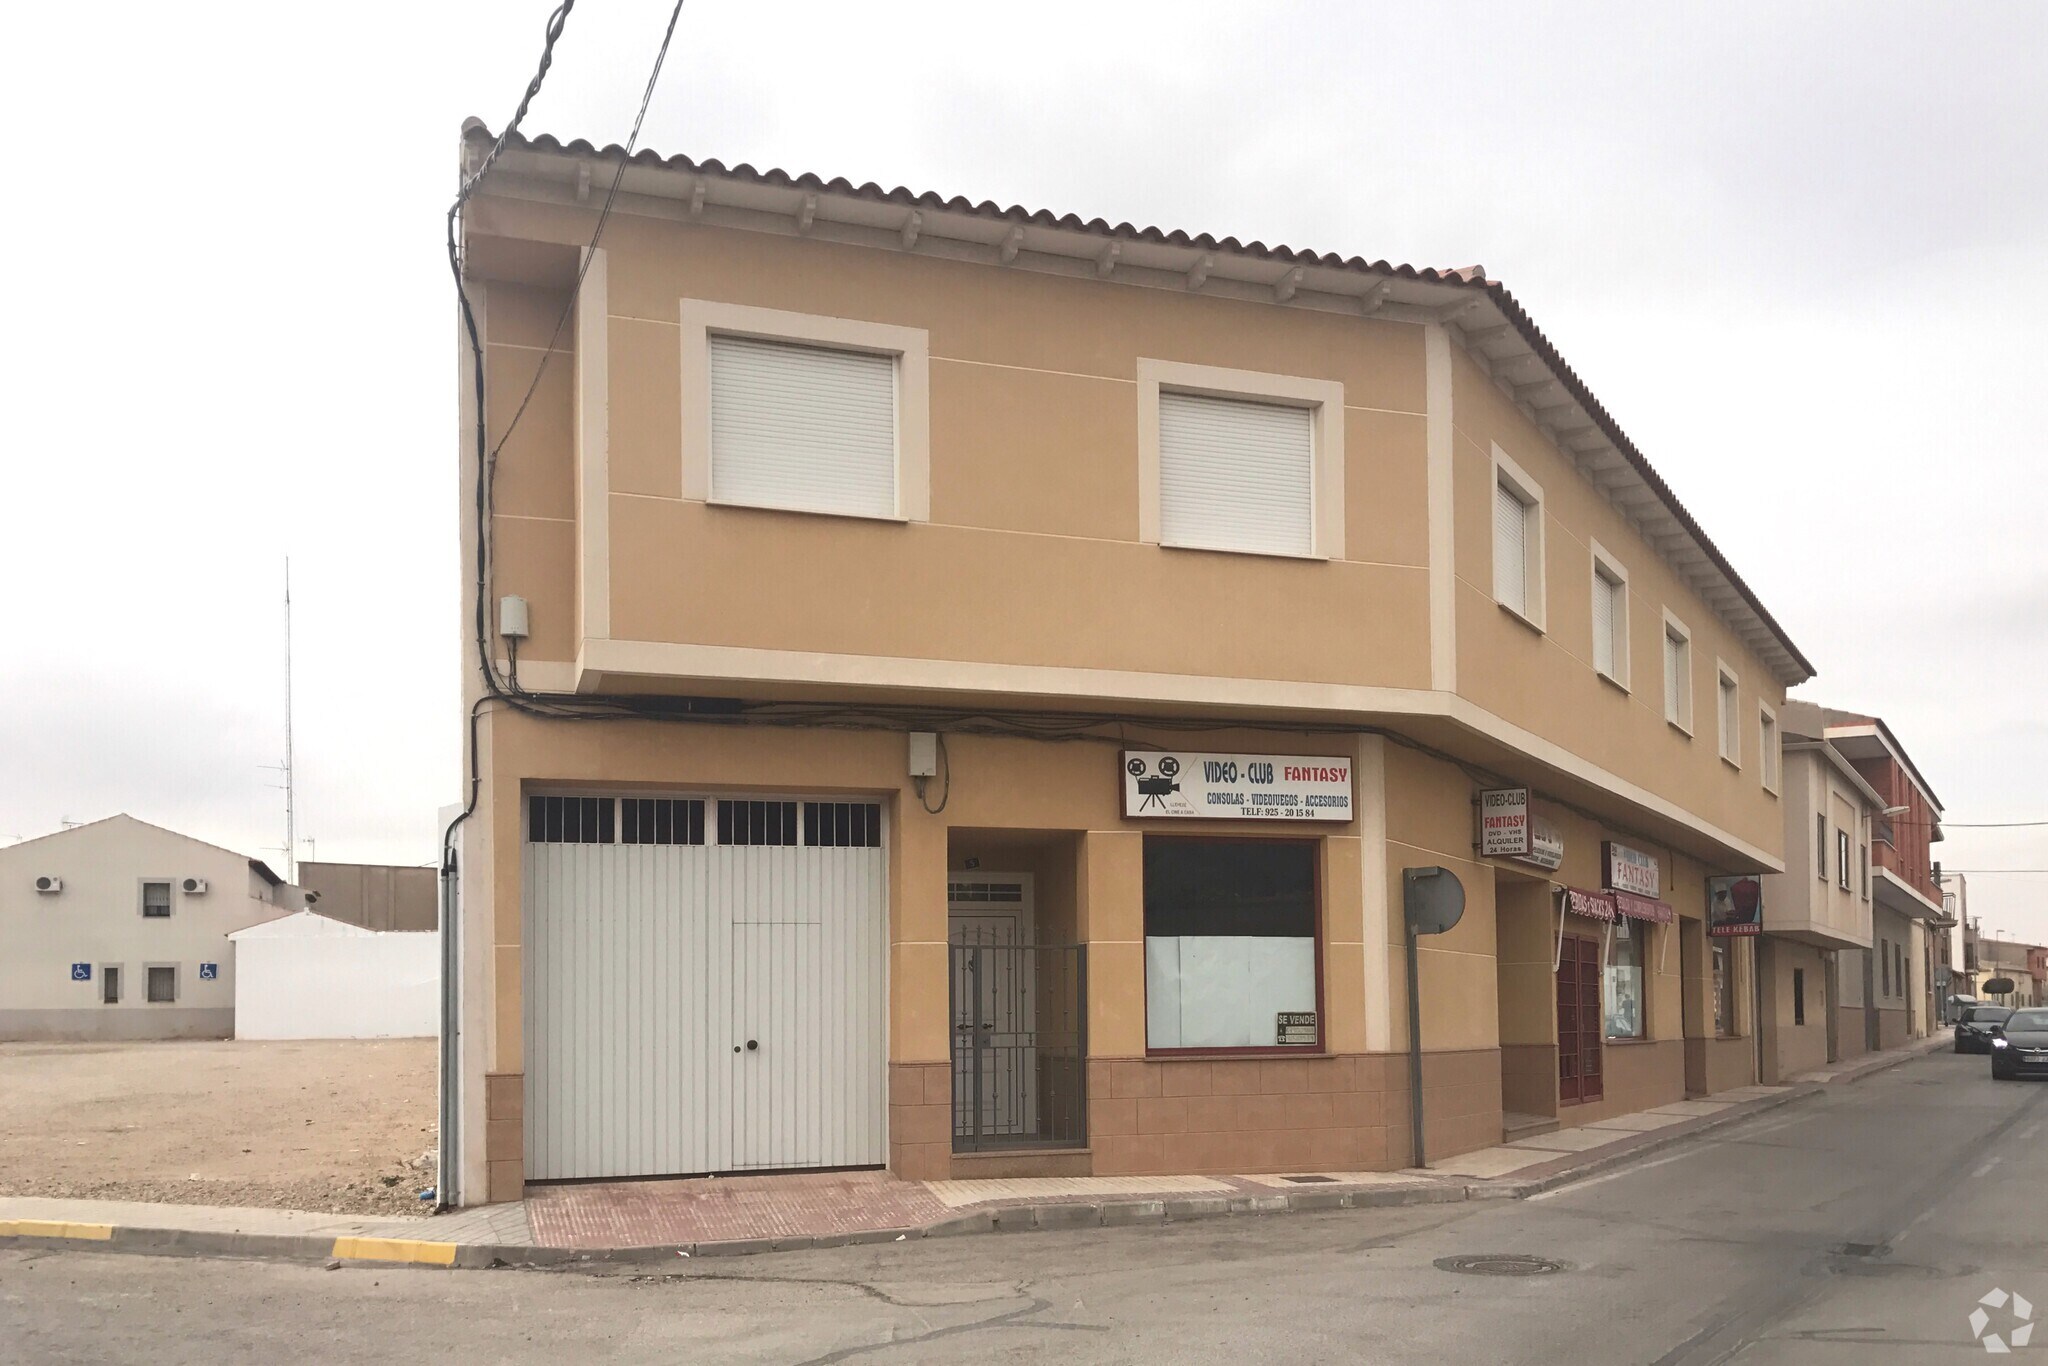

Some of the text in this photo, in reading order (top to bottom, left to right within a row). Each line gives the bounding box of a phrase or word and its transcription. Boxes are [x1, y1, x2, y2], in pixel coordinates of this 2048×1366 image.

[1203, 761, 1237, 784] VIDEO
[1248, 763, 1274, 784] CLUB
[1284, 766, 1347, 782] FANTASY
[1207, 792, 1244, 805] CONSOLAS
[1251, 793, 1298, 806] VIDEOJUEGOS
[1305, 796, 1348, 808] ACCESORIOS
[1241, 807, 1264, 816] TELF:
[1265, 808, 1279, 816] 925
[1284, 809, 1294, 817] 20
[1295, 809, 1303, 817] 15
[1304, 809, 1315, 818] 84
[1484, 815, 1525, 829] FANTASY
[1487, 837, 1524, 845] ALQUILER
[1617, 862, 1655, 888] FANTASY
[1712, 925, 1760, 934] TELE KEBAB
[1278, 1015, 1315, 1024] SE VENDE
